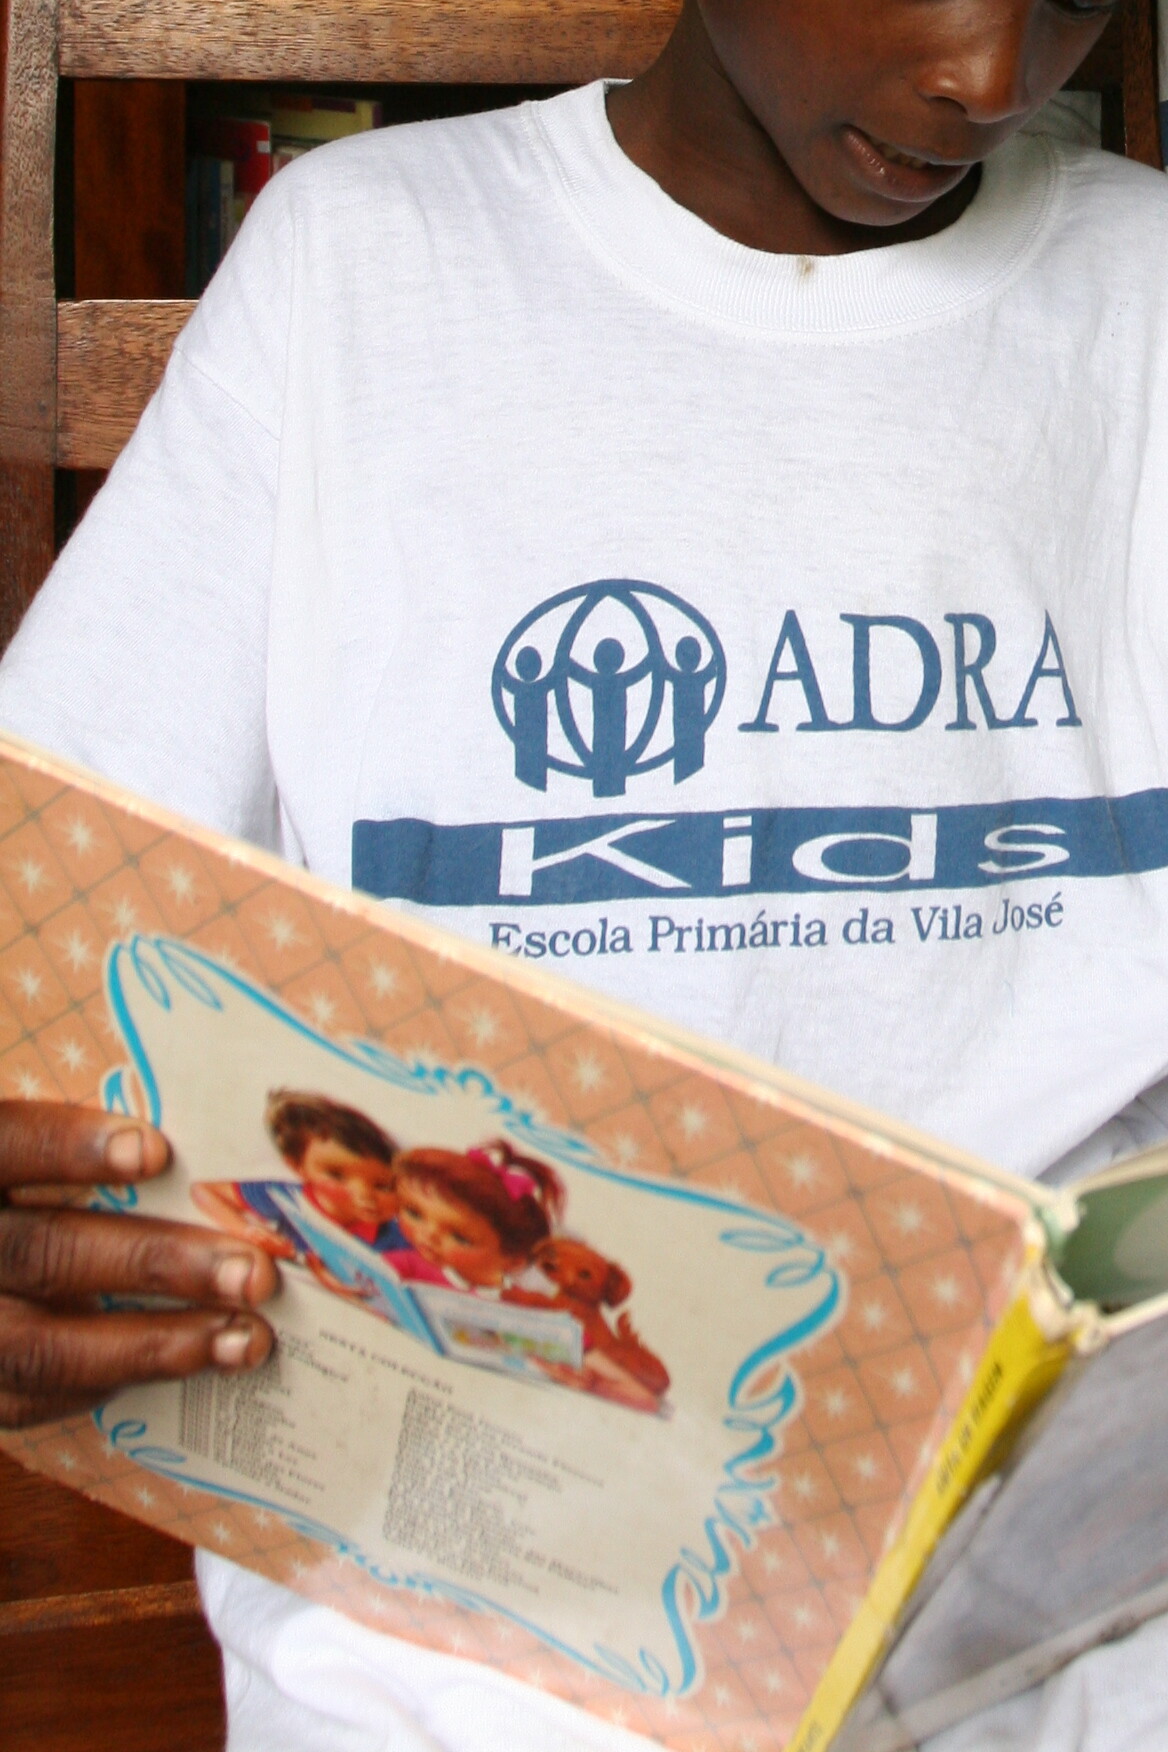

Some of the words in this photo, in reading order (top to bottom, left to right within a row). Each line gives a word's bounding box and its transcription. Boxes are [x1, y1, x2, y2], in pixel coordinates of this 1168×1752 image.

[737, 608, 1083, 733] ADRA
[499, 813, 1070, 896] Kids
[488, 919, 633, 959] Escola
[648, 910, 827, 954] Primária
[842, 909, 895, 947] da
[911, 905, 984, 942] Vila
[993, 892, 1065, 935] José
